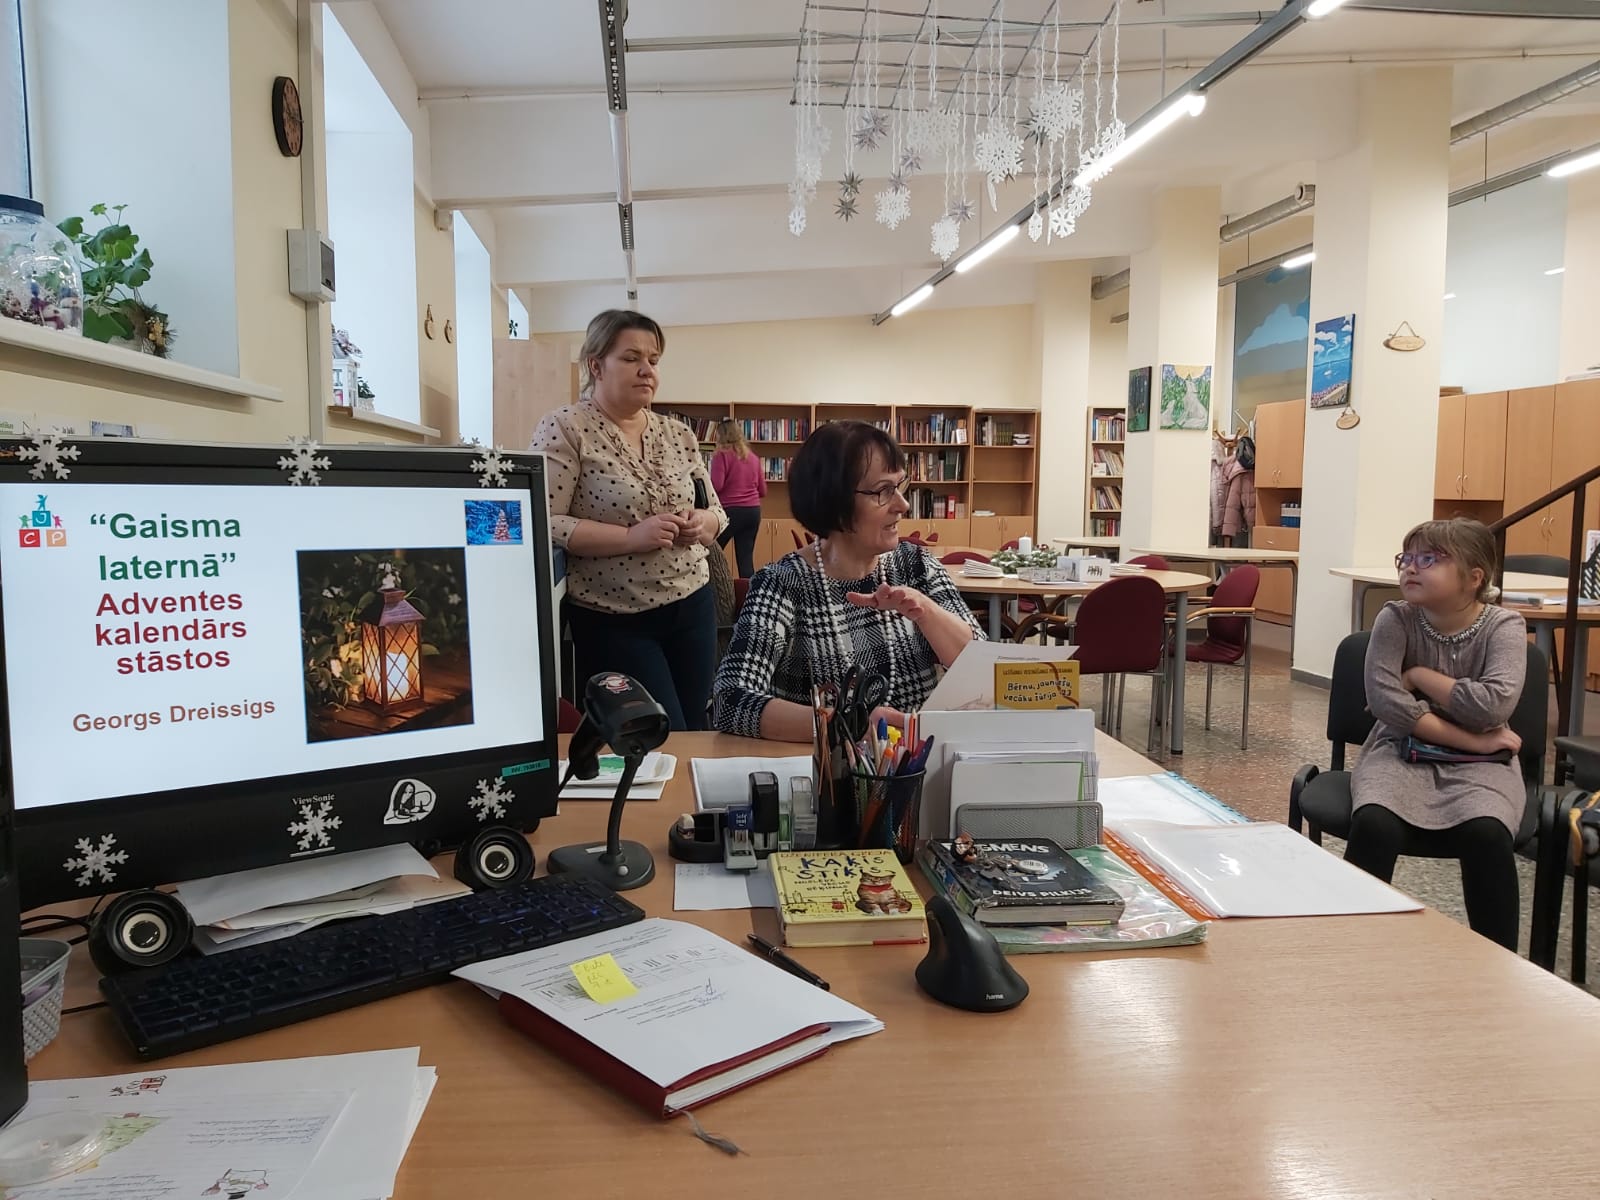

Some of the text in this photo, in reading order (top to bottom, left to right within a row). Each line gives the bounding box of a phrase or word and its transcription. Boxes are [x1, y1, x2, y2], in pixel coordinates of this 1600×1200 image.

[96, 590, 243, 617] Adventes
[95, 618, 247, 647] kalendārs
[116, 648, 231, 675] stāstos
[72, 699, 276, 732] Georgs Dreissigs
[992, 889, 1037, 898] DEIVS
